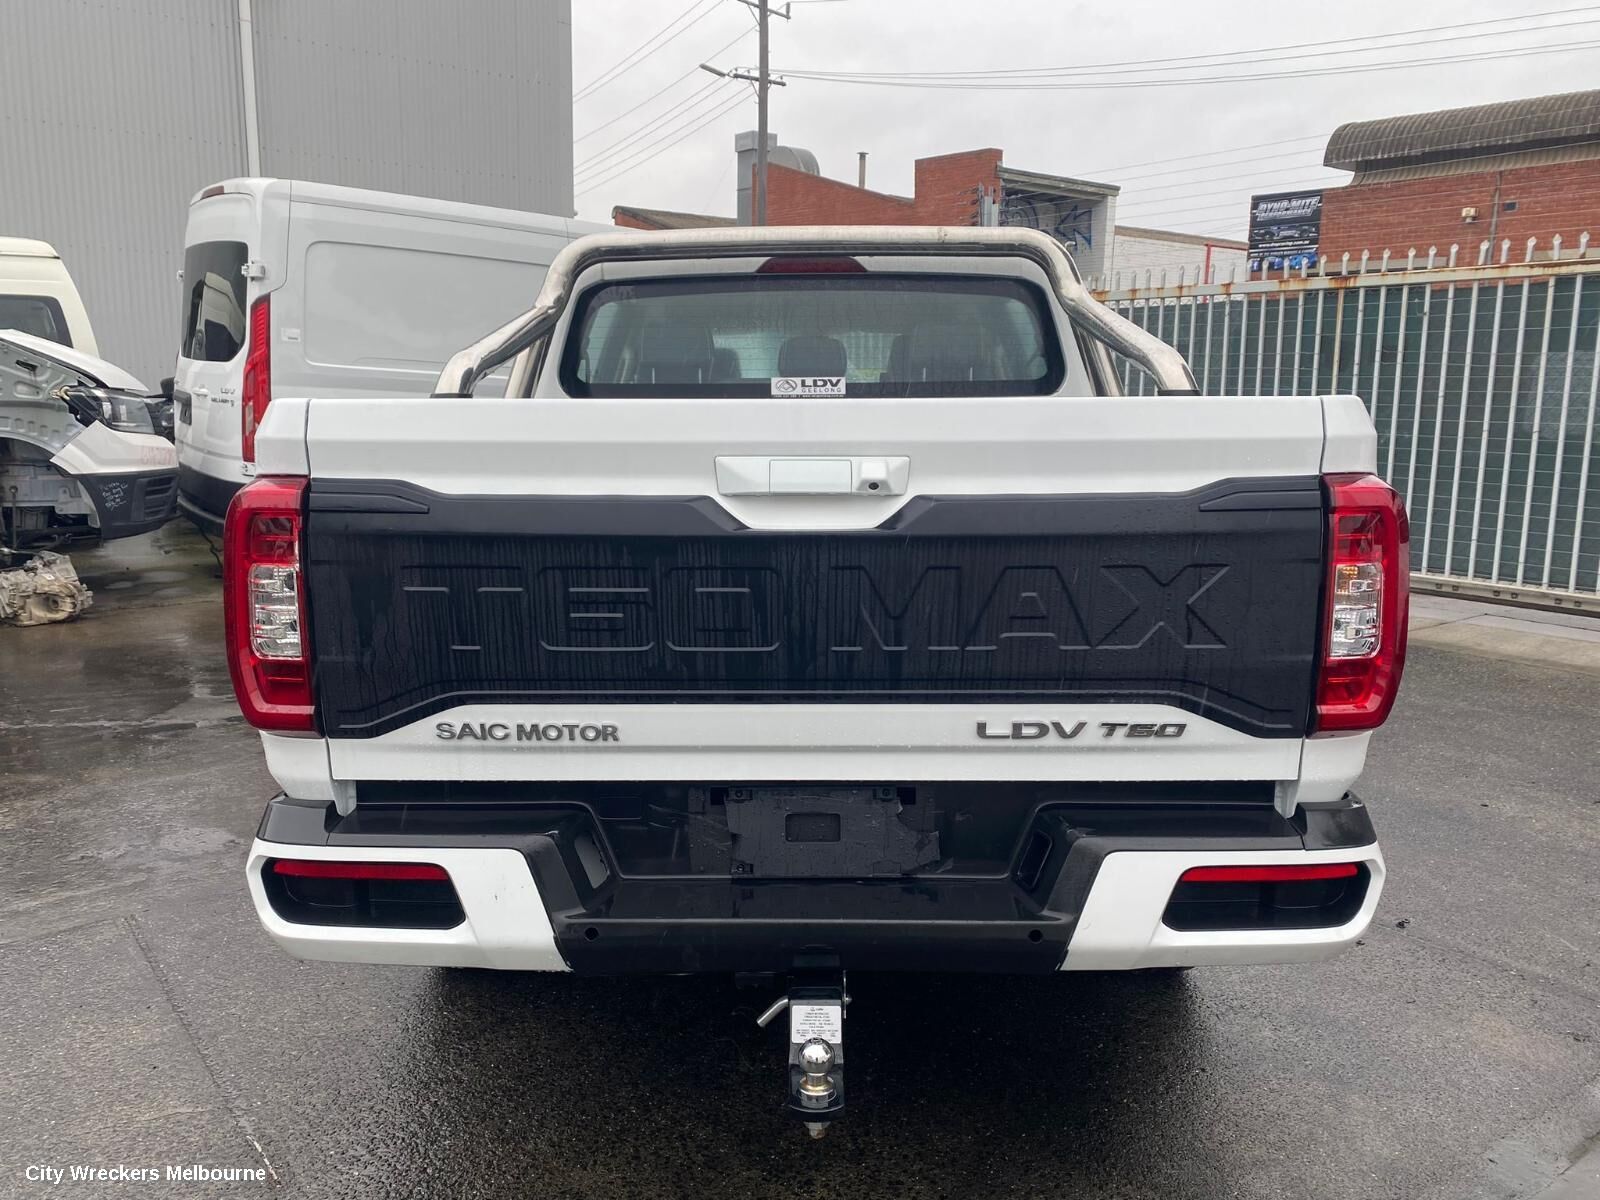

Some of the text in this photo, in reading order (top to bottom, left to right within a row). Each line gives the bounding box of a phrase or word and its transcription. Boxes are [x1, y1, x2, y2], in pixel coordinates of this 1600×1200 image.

[801, 378, 842, 388] LDV
[829, 563, 1231, 650] MAX
[435, 722, 620, 742] SAIC MOTOR
[976, 721, 1188, 740] LDV T60
